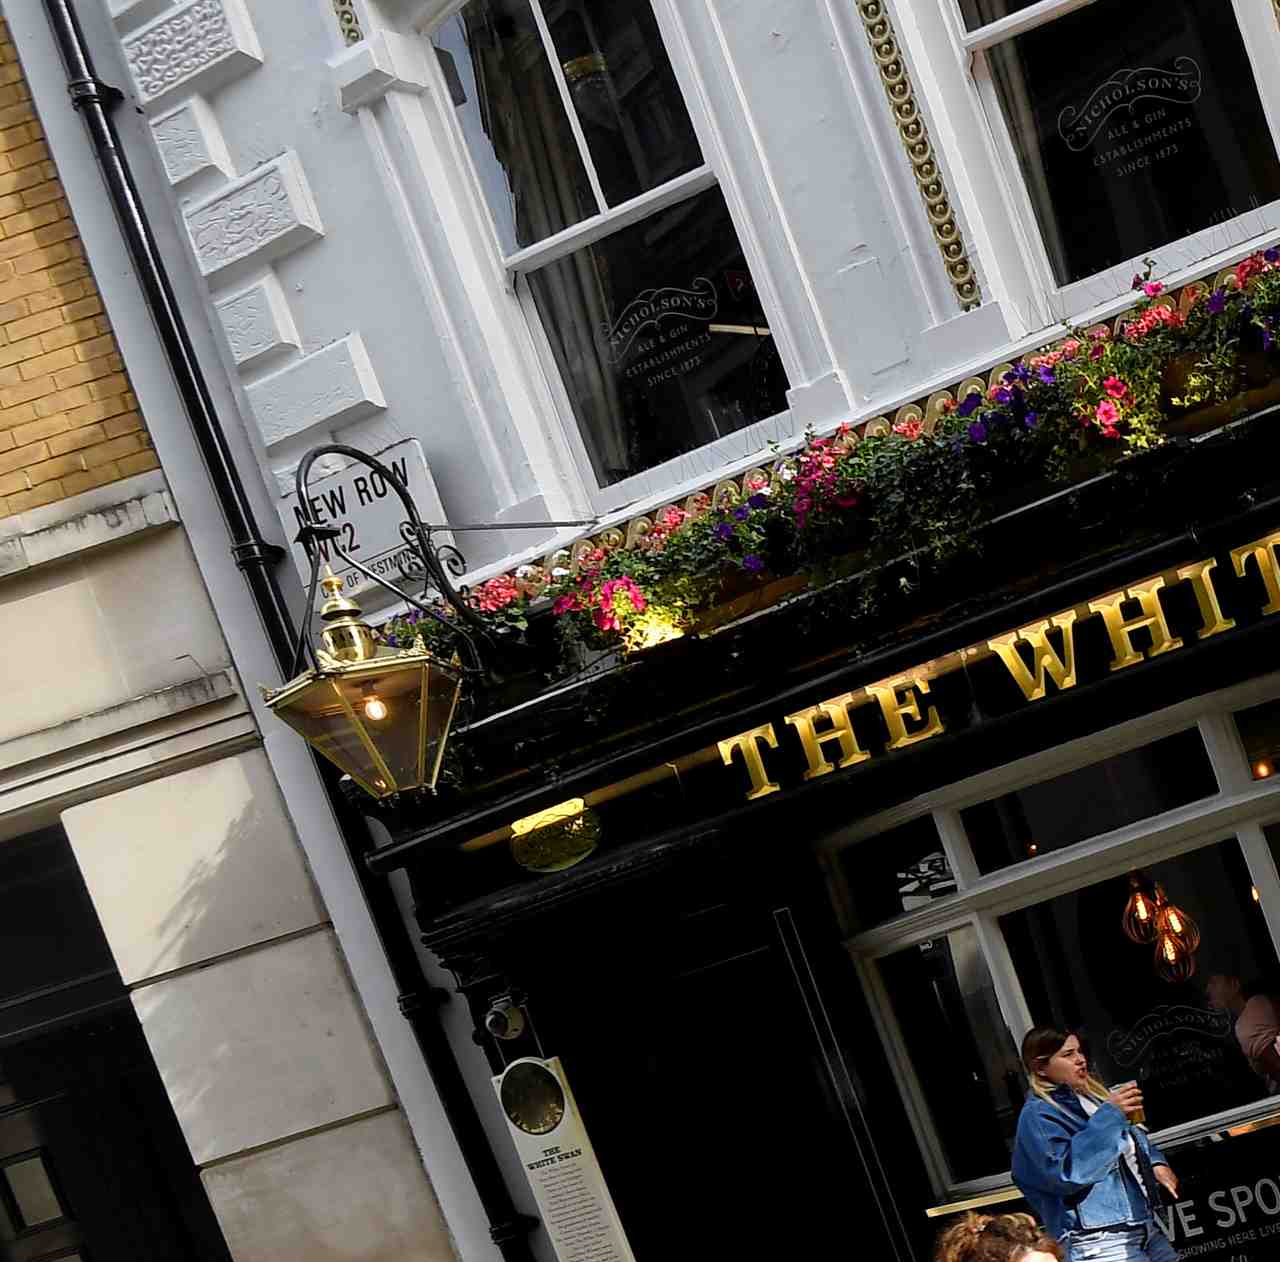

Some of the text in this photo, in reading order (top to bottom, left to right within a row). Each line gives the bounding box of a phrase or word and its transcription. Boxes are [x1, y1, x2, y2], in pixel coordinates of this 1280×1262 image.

[1108, 123, 1128, 140] ALE
[1145, 107, 1166, 124] GIN
[1093, 117, 1192, 167] ESTABLISHMENTS
[293, 457, 409, 529] NEW ROW
[346, 572, 361, 588] OF
[717, 674, 945, 801] THE
[527, 1148, 582, 1170] WHITE SWAN
[542, 1145, 562, 1157] THE
[1153, 1199, 1204, 1242] VE
[1178, 1237, 1227, 1261] SHOWING
[1229, 1229, 1258, 1247] HERE
